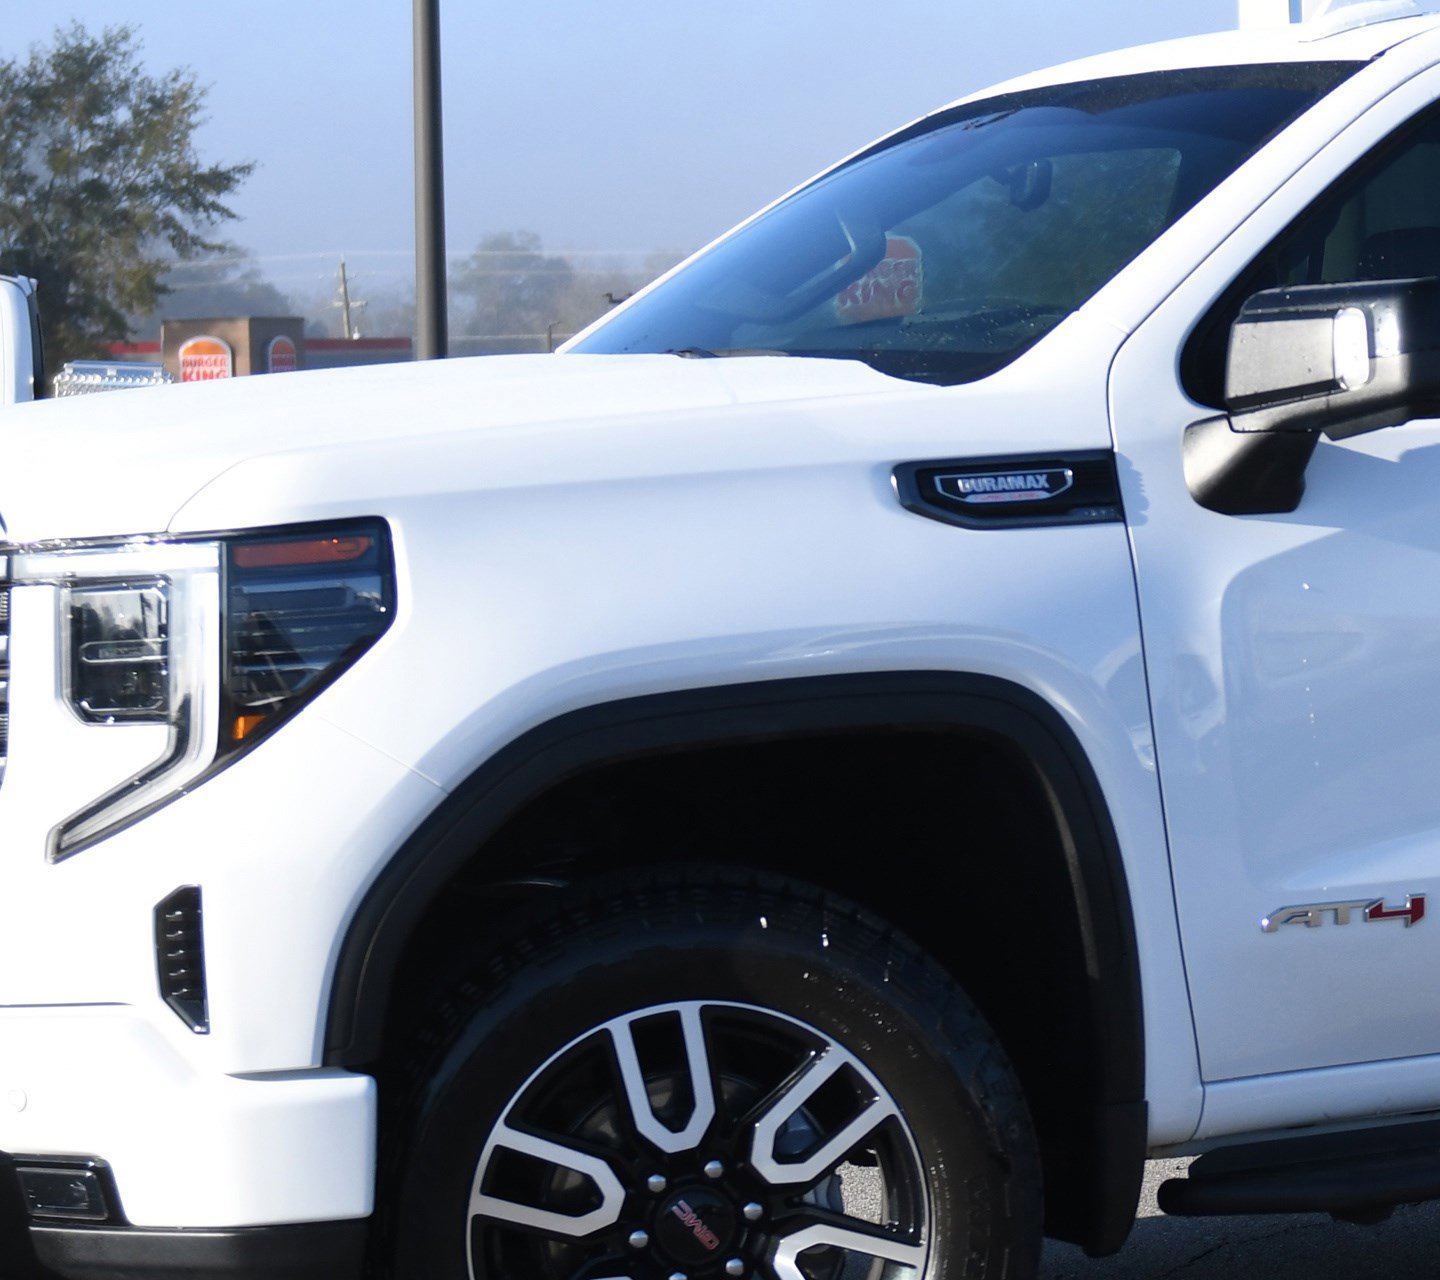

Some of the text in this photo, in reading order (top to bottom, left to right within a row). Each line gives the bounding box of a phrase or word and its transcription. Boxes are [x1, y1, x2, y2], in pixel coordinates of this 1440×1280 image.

[182, 357, 227, 368] BURGER
[958, 473, 1050, 494] DURAMAX
[1261, 892, 1426, 933] AT4
[671, 1200, 720, 1250] GMC
